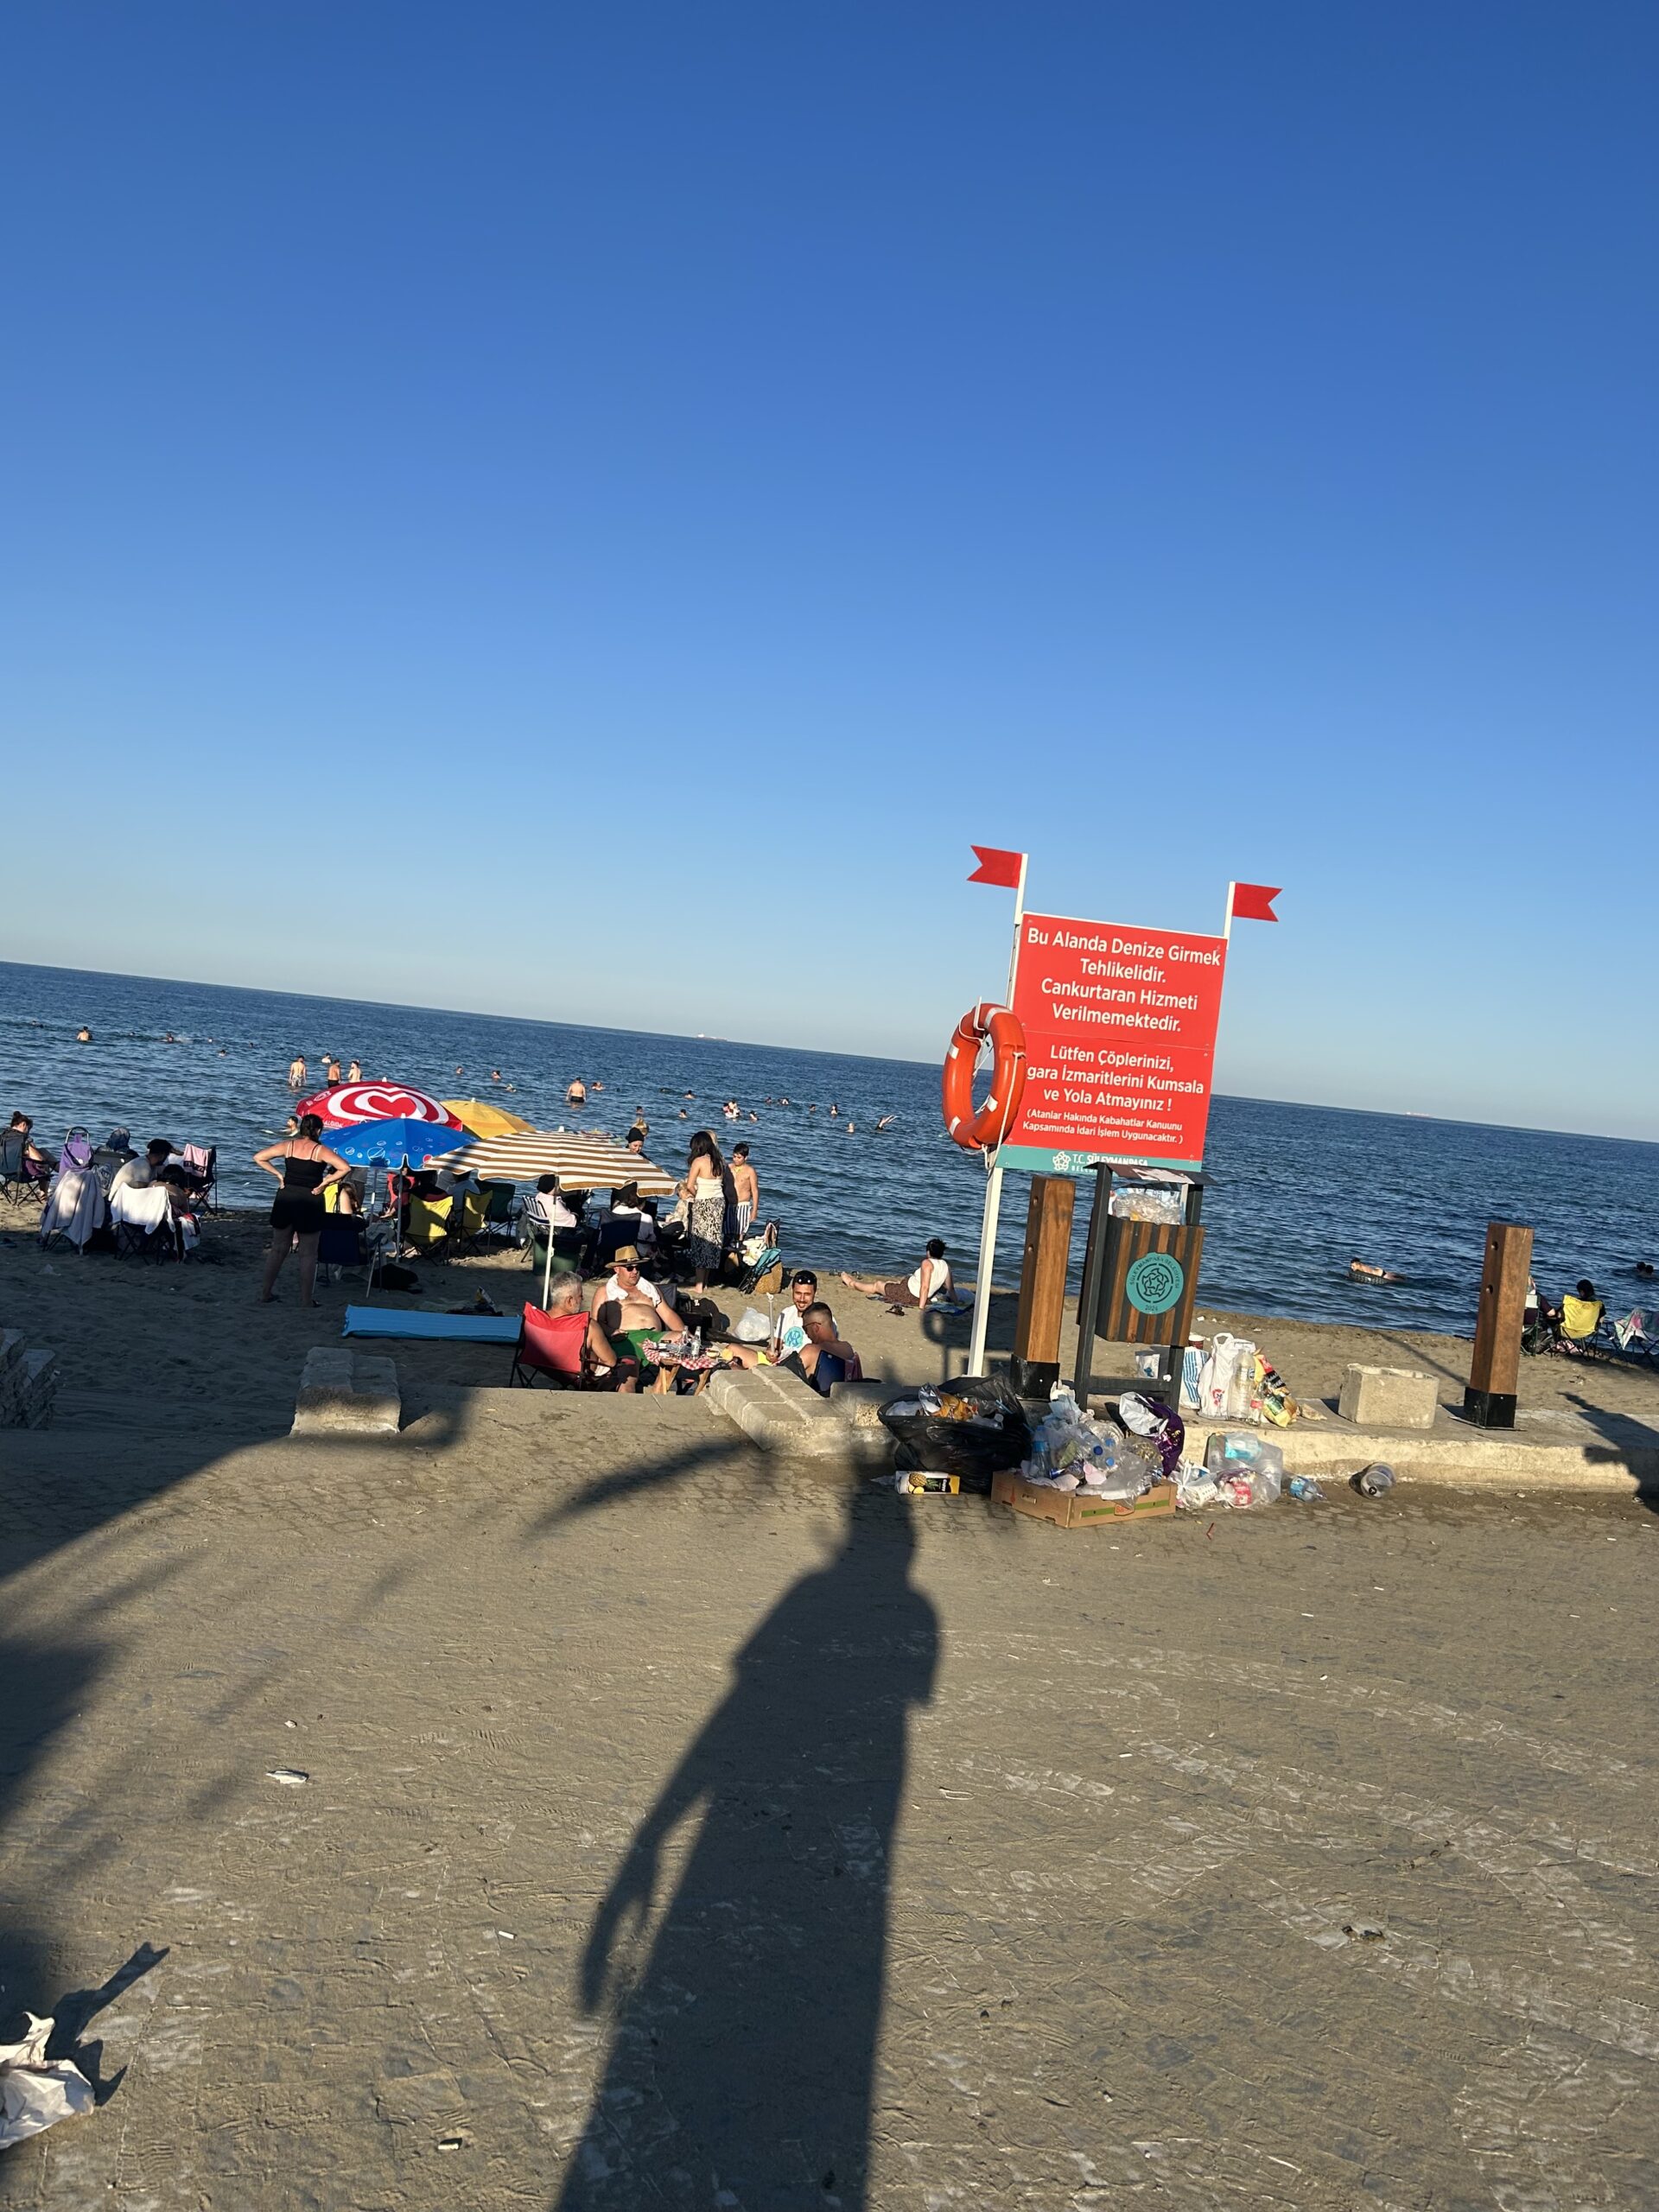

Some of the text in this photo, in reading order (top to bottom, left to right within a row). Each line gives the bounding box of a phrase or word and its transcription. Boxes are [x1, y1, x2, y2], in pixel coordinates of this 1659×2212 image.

[1027, 927, 1221, 966] Bu Alanda Denize Girmek
[1080, 957, 1166, 982] Tehlikelidir.
[1041, 977, 1198, 1010] Cankurtaran Hizmeti
[1052, 1003, 1180, 1032] Verilmemektedir.
[1051, 1045, 1173, 1074] Lütfen Çöplerinizi,
[1027, 1065, 1204, 1094] gara İzmaritlerini Kumsala
[1044, 1090, 1059, 1101] ve
[1064, 1088, 1092, 1103] Yola
[1095, 1091, 1164, 1110] Atmayınız
[1023, 1121, 1075, 1134] Kapsamında
[1077, 1124, 1096, 1135] İdari
[1027, 1109, 1062, 1120] (Atanlar
[1064, 1112, 1097, 1123] Hakında
[1099, 1115, 1145, 1127] Kabahatlar
[1072, 1154, 1085, 1165] T.C.
